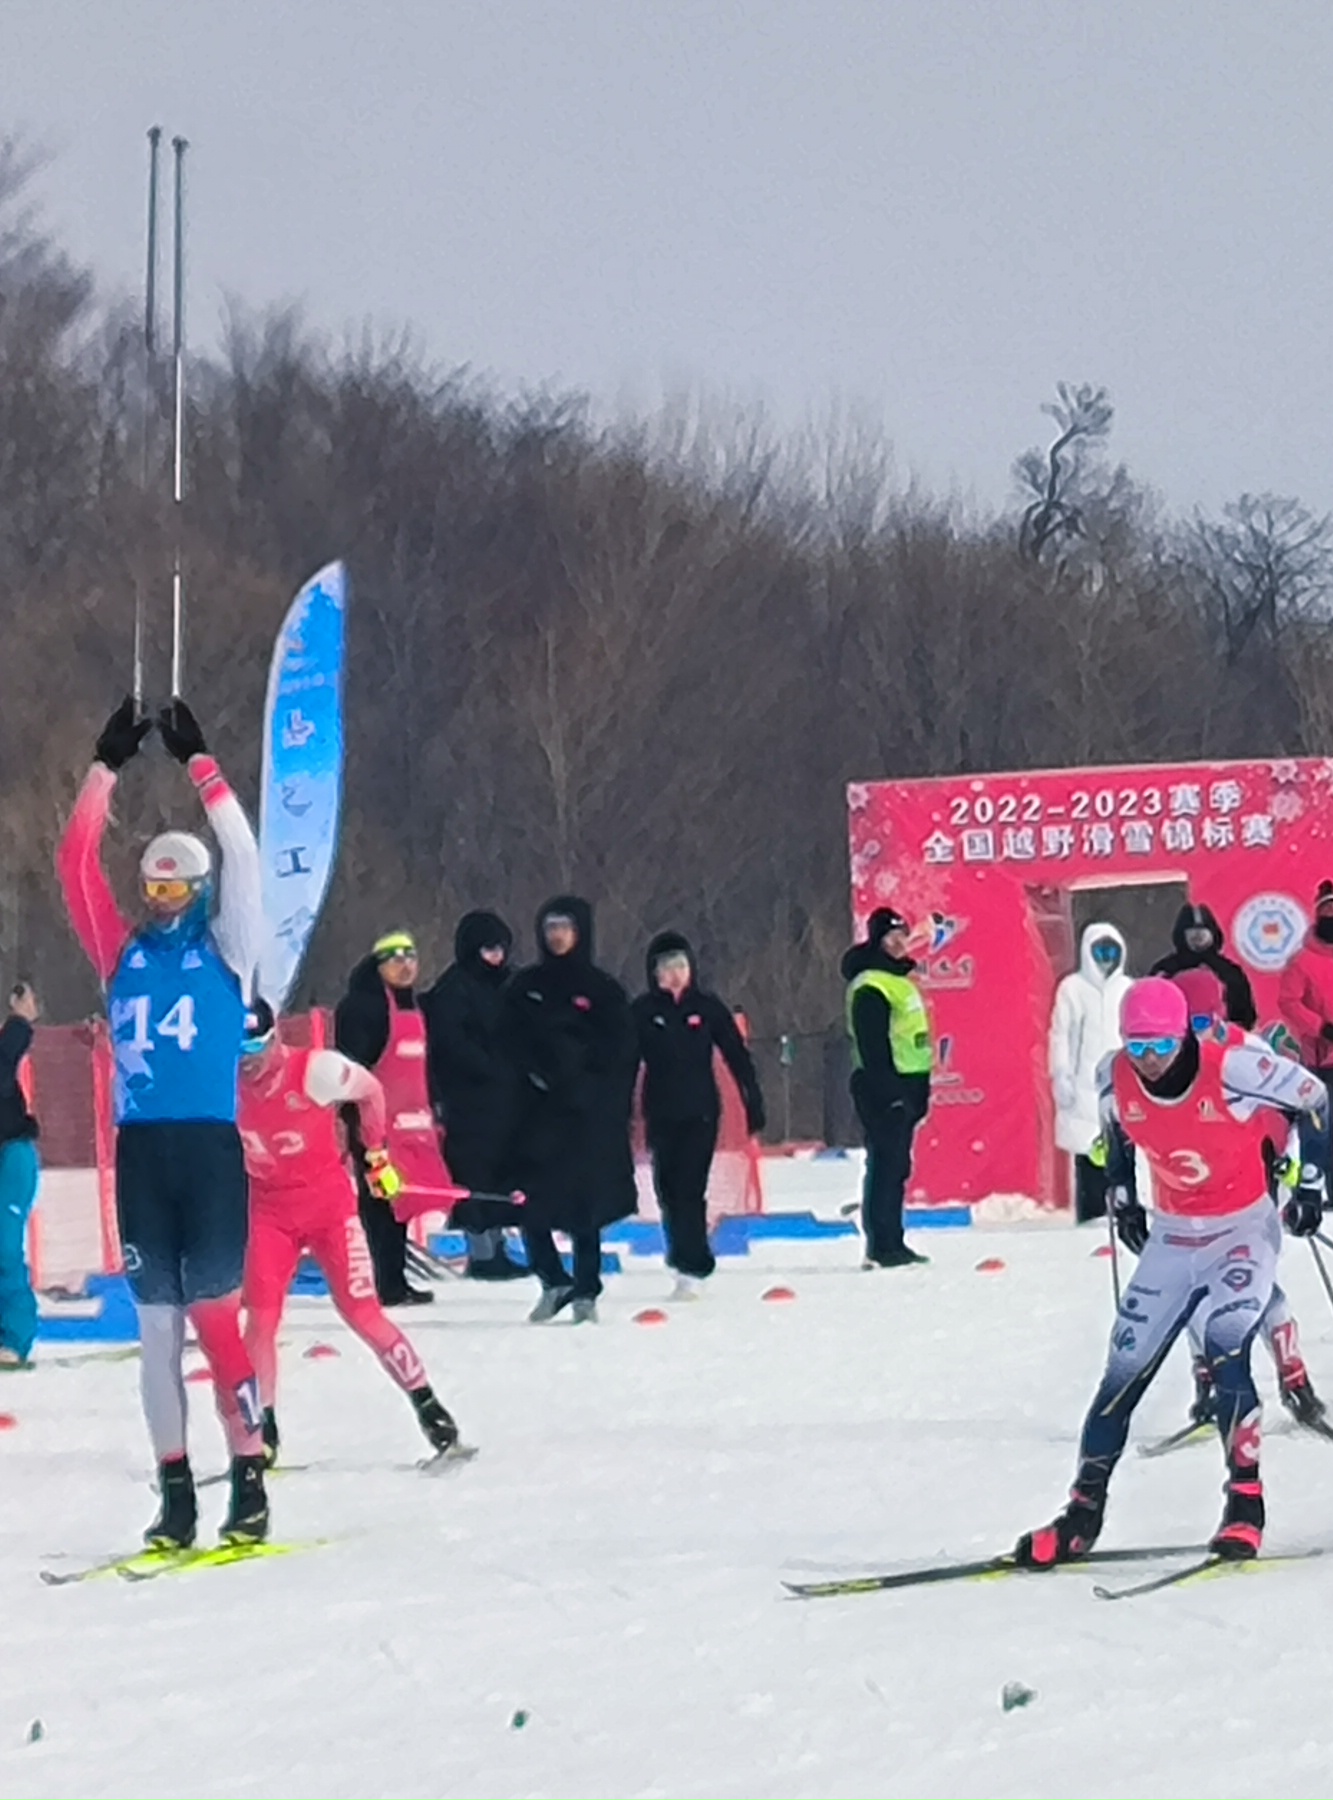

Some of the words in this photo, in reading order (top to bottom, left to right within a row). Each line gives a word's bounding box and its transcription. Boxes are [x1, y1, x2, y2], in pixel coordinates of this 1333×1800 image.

[950, 779, 1242, 825] 2022-2023赛季
[922, 814, 1275, 864] 全国越野滑雪锦标赛
[130, 994, 199, 1051] 14
[1168, 1148, 1212, 1186] 3
[385, 1341, 424, 1385] 12
